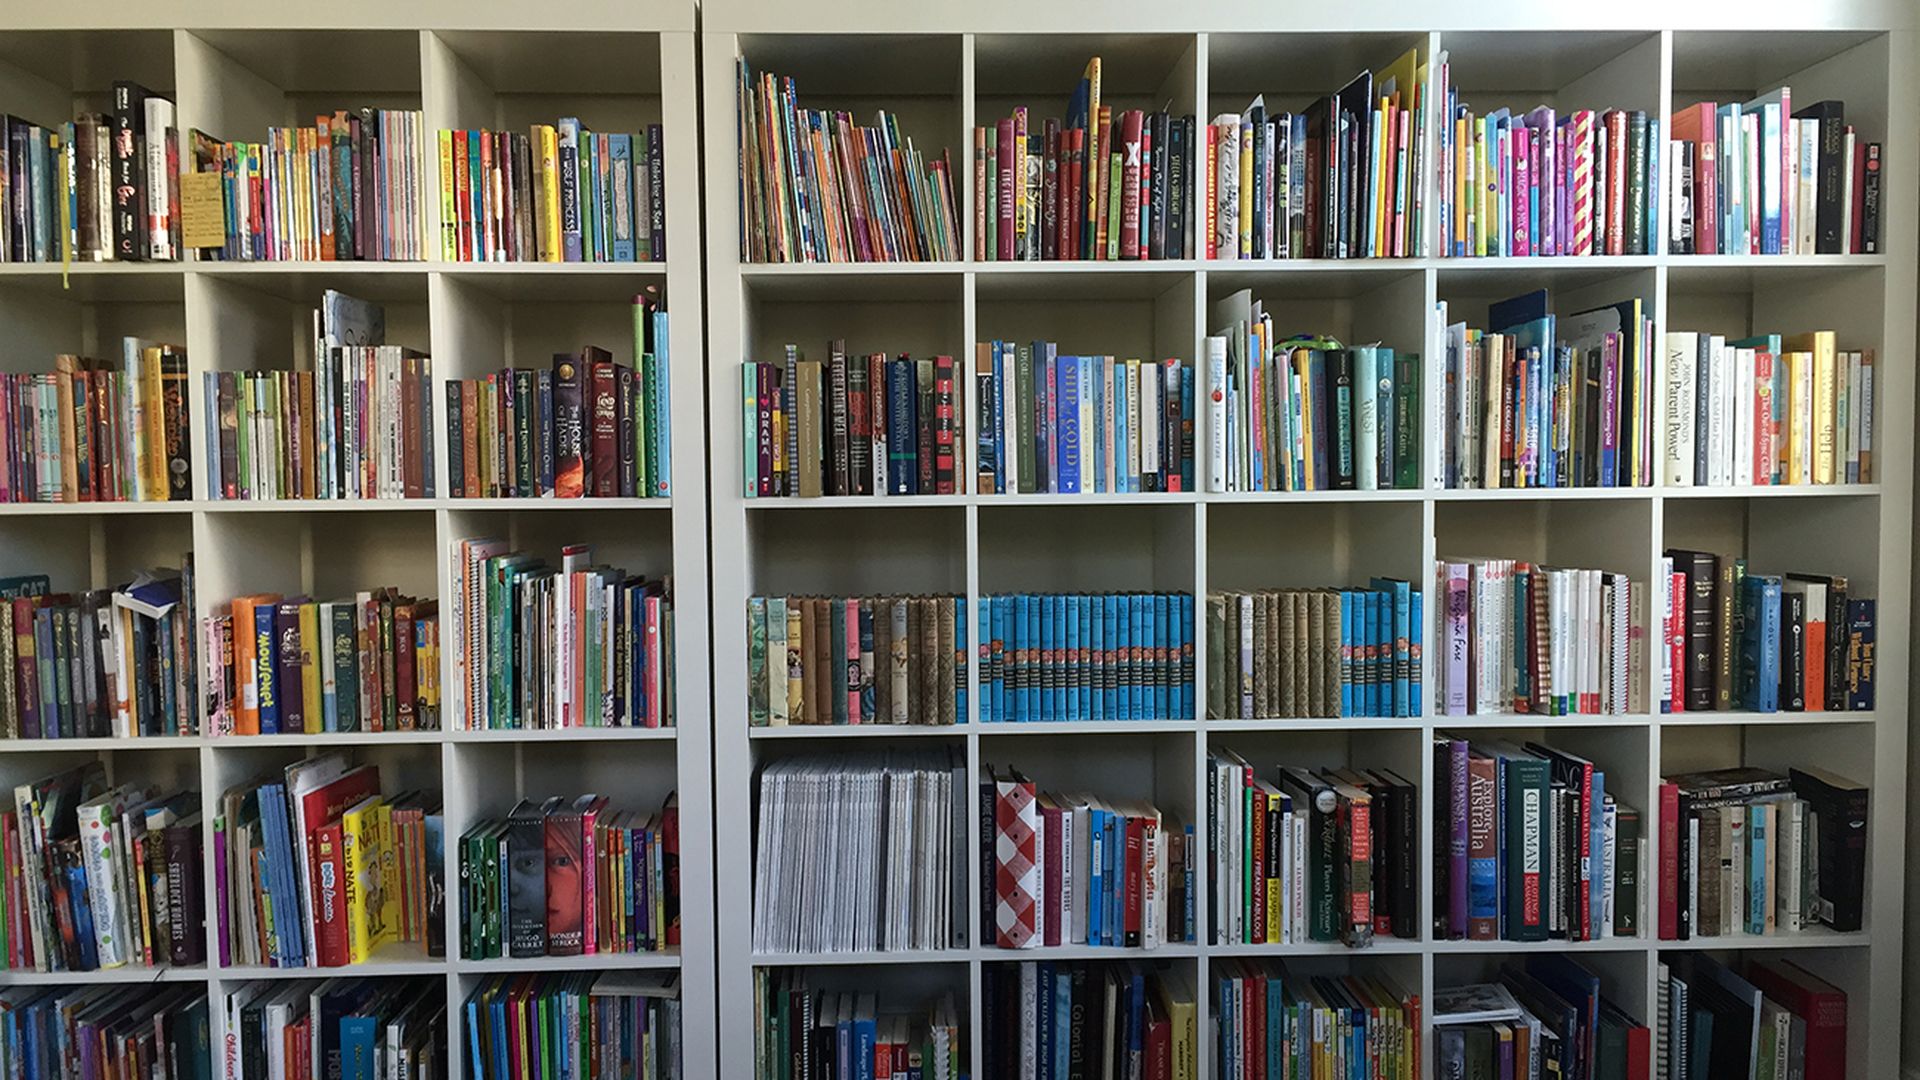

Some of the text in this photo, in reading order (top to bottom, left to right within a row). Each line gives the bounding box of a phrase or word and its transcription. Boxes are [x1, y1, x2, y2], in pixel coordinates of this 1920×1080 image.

[1207, 143, 1216, 160] THE
[563, 160, 574, 187] WOLF
[1153, 172, 1162, 186] Out
[1207, 161, 1216, 195] DUMBEST
[565, 189, 576, 232] PRINCESS
[652, 209, 662, 230] Spell
[1208, 196, 1216, 217] IDEA
[1683, 364, 1691, 386] JOHN
[1065, 364, 1078, 466] SHIP GOLD
[1668, 349, 1683, 461] New Parent Power!
[1761, 397, 1769, 410] The
[556, 405, 568, 457] OF HADES
[569, 405, 582, 457] THE HOUSE
[761, 411, 769, 455] DRAMA
[1820, 425, 1833, 453] Help
[1761, 456, 1769, 478] Child
[1454, 589, 1466, 663] Virginia Fare
[983, 794, 994, 843] JAMIE OLIVER
[1254, 801, 1262, 837] CLINTON
[1471, 773, 1487, 850] Australia
[1483, 781, 1494, 830] Explore
[1128, 836, 1139, 850] lit
[1254, 838, 1262, 860] KELLY
[1525, 792, 1537, 870] CHAPMAN
[1129, 871, 1137, 889] mary
[1603, 834, 1613, 899] AUSTRALIA
[168, 862, 183, 941] SHERLOCK HOLMES
[346, 870, 356, 905] NATE
[1324, 864, 1332, 934] Players Dictionary
[1253, 898, 1261, 938] FABULOUS
[1071, 1004, 1084, 1064] Colonial
